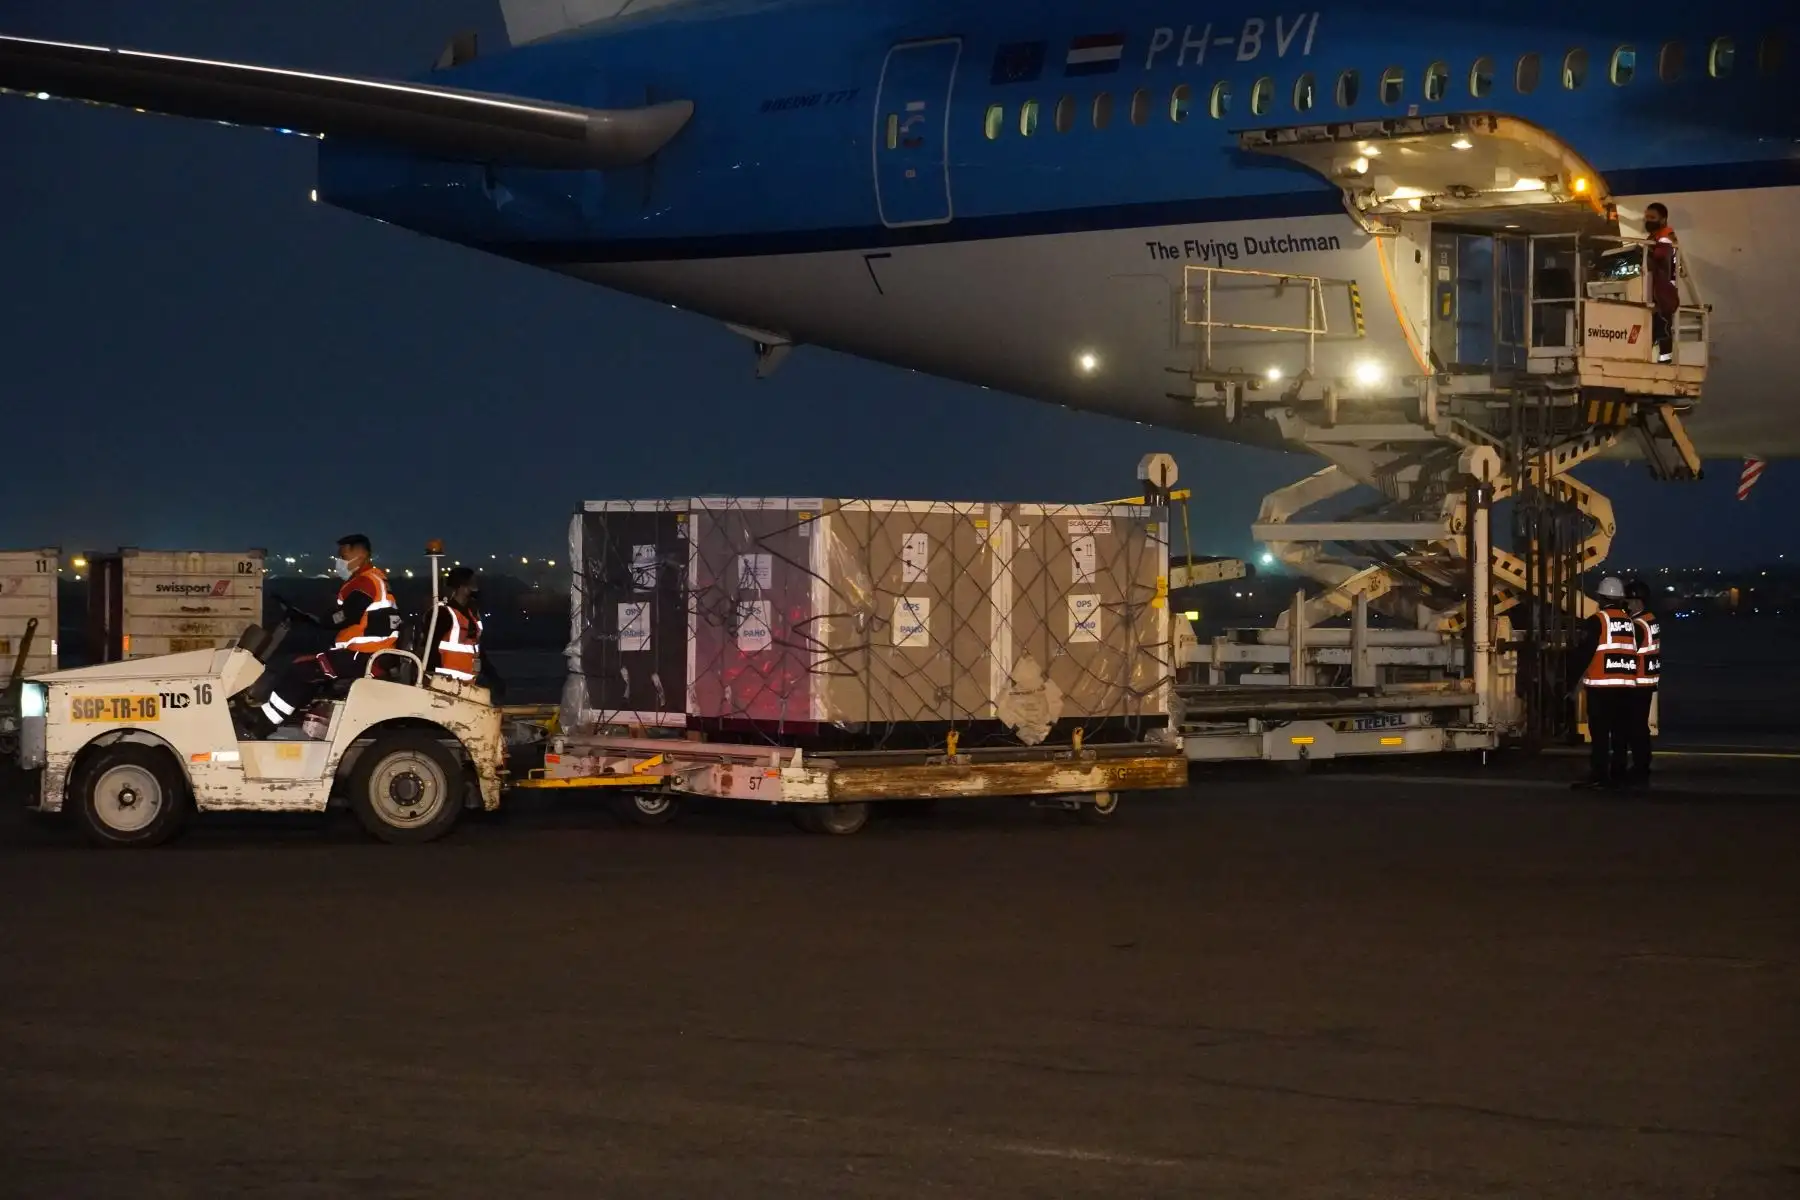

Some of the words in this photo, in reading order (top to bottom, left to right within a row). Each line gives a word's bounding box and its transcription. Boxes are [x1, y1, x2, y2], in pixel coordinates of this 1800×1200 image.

[1145, 12, 1319, 70] PH-BVI
[1146, 240, 1180, 260] The
[1184, 238, 1240, 262] Flying
[1244, 233, 1341, 255] Dutchman
[1588, 324, 1628, 342] swissport
[35, 560, 48, 573] 11
[238, 562, 253, 574] 02
[156, 582, 212, 595] swissport
[1076, 600, 1092, 608] OPS
[193, 683, 213, 705] 16
[72, 697, 157, 720] SGP-TR-16
[749, 776, 762, 790] 57
